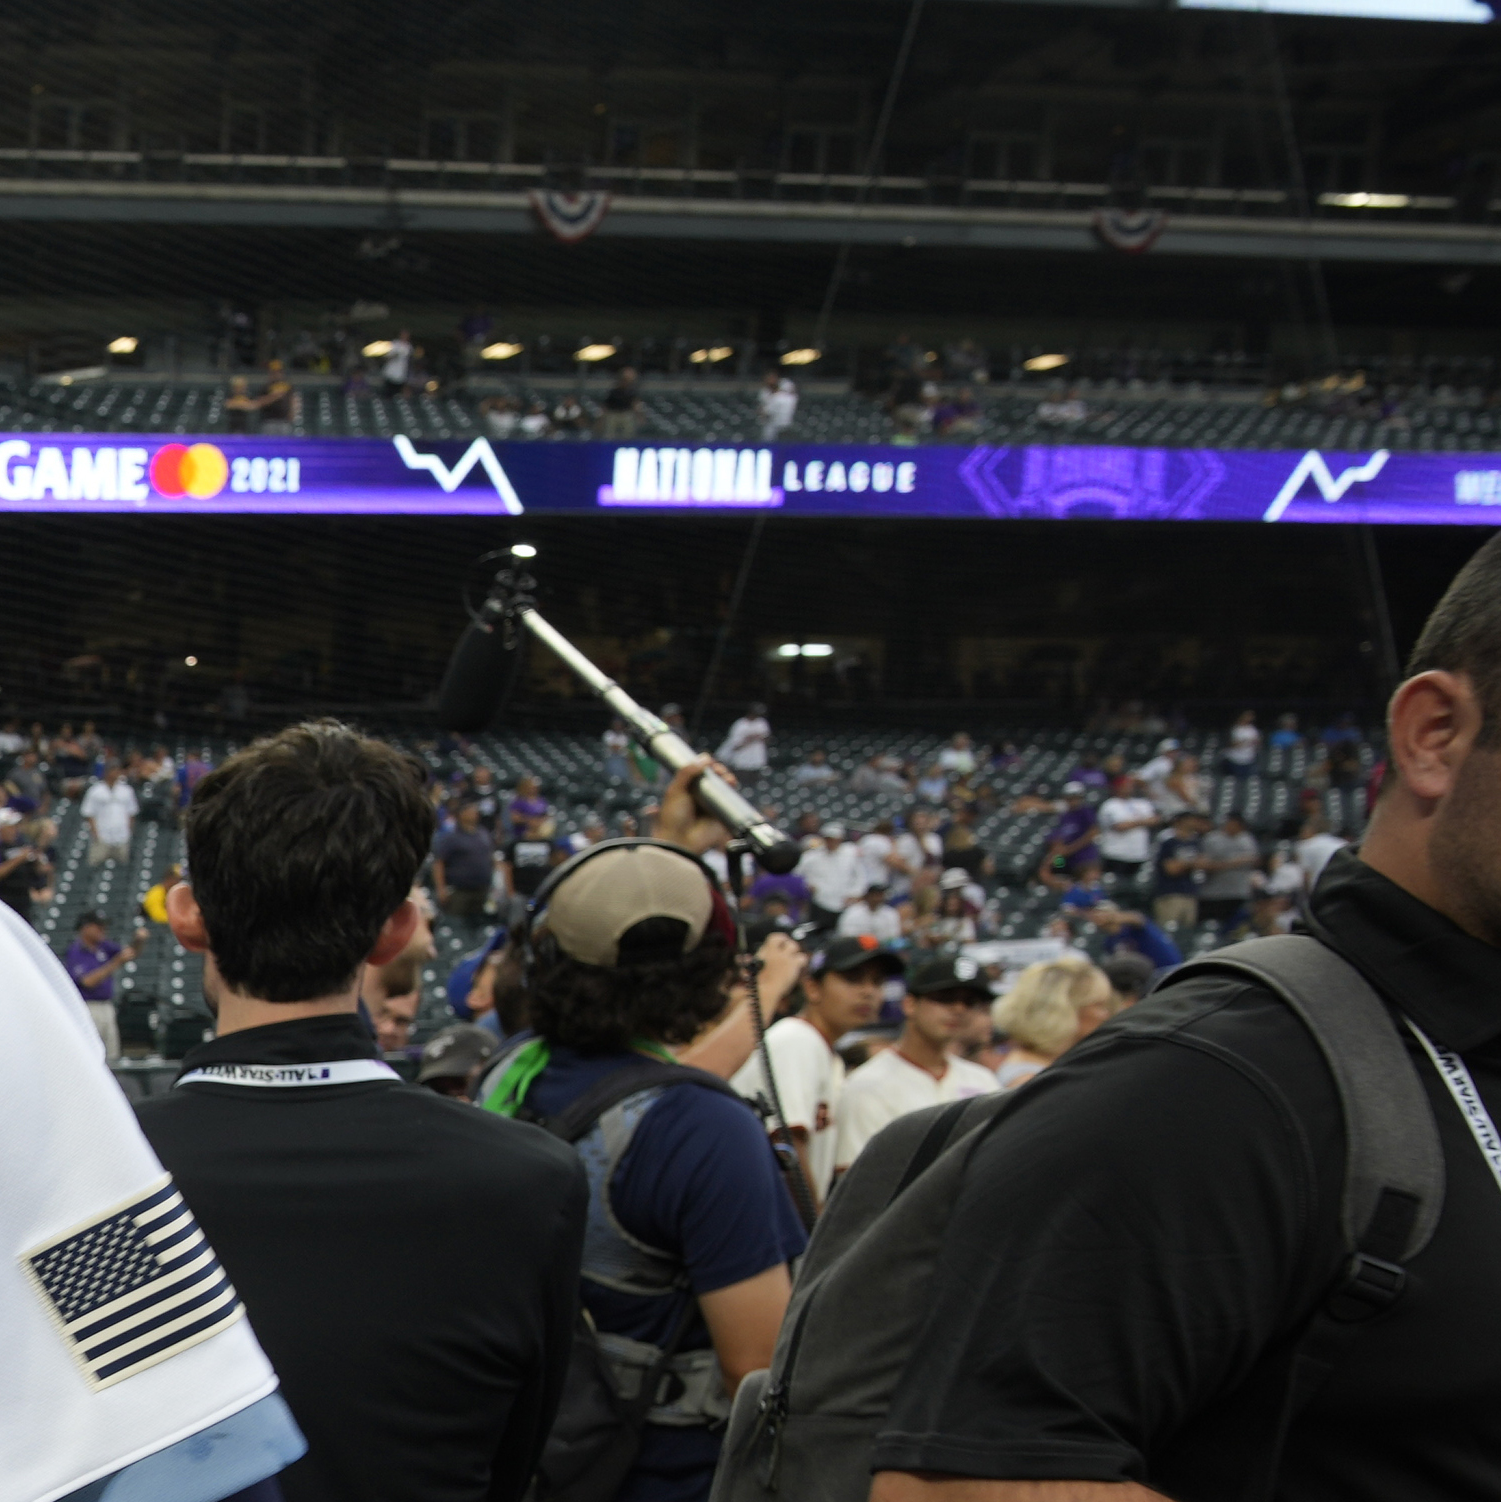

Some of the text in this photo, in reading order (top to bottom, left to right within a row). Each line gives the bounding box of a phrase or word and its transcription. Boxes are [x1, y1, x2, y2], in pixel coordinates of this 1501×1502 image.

[230, 456, 301, 493] 2021
[611, 447, 917, 501] NATIONAL LEAGUE
